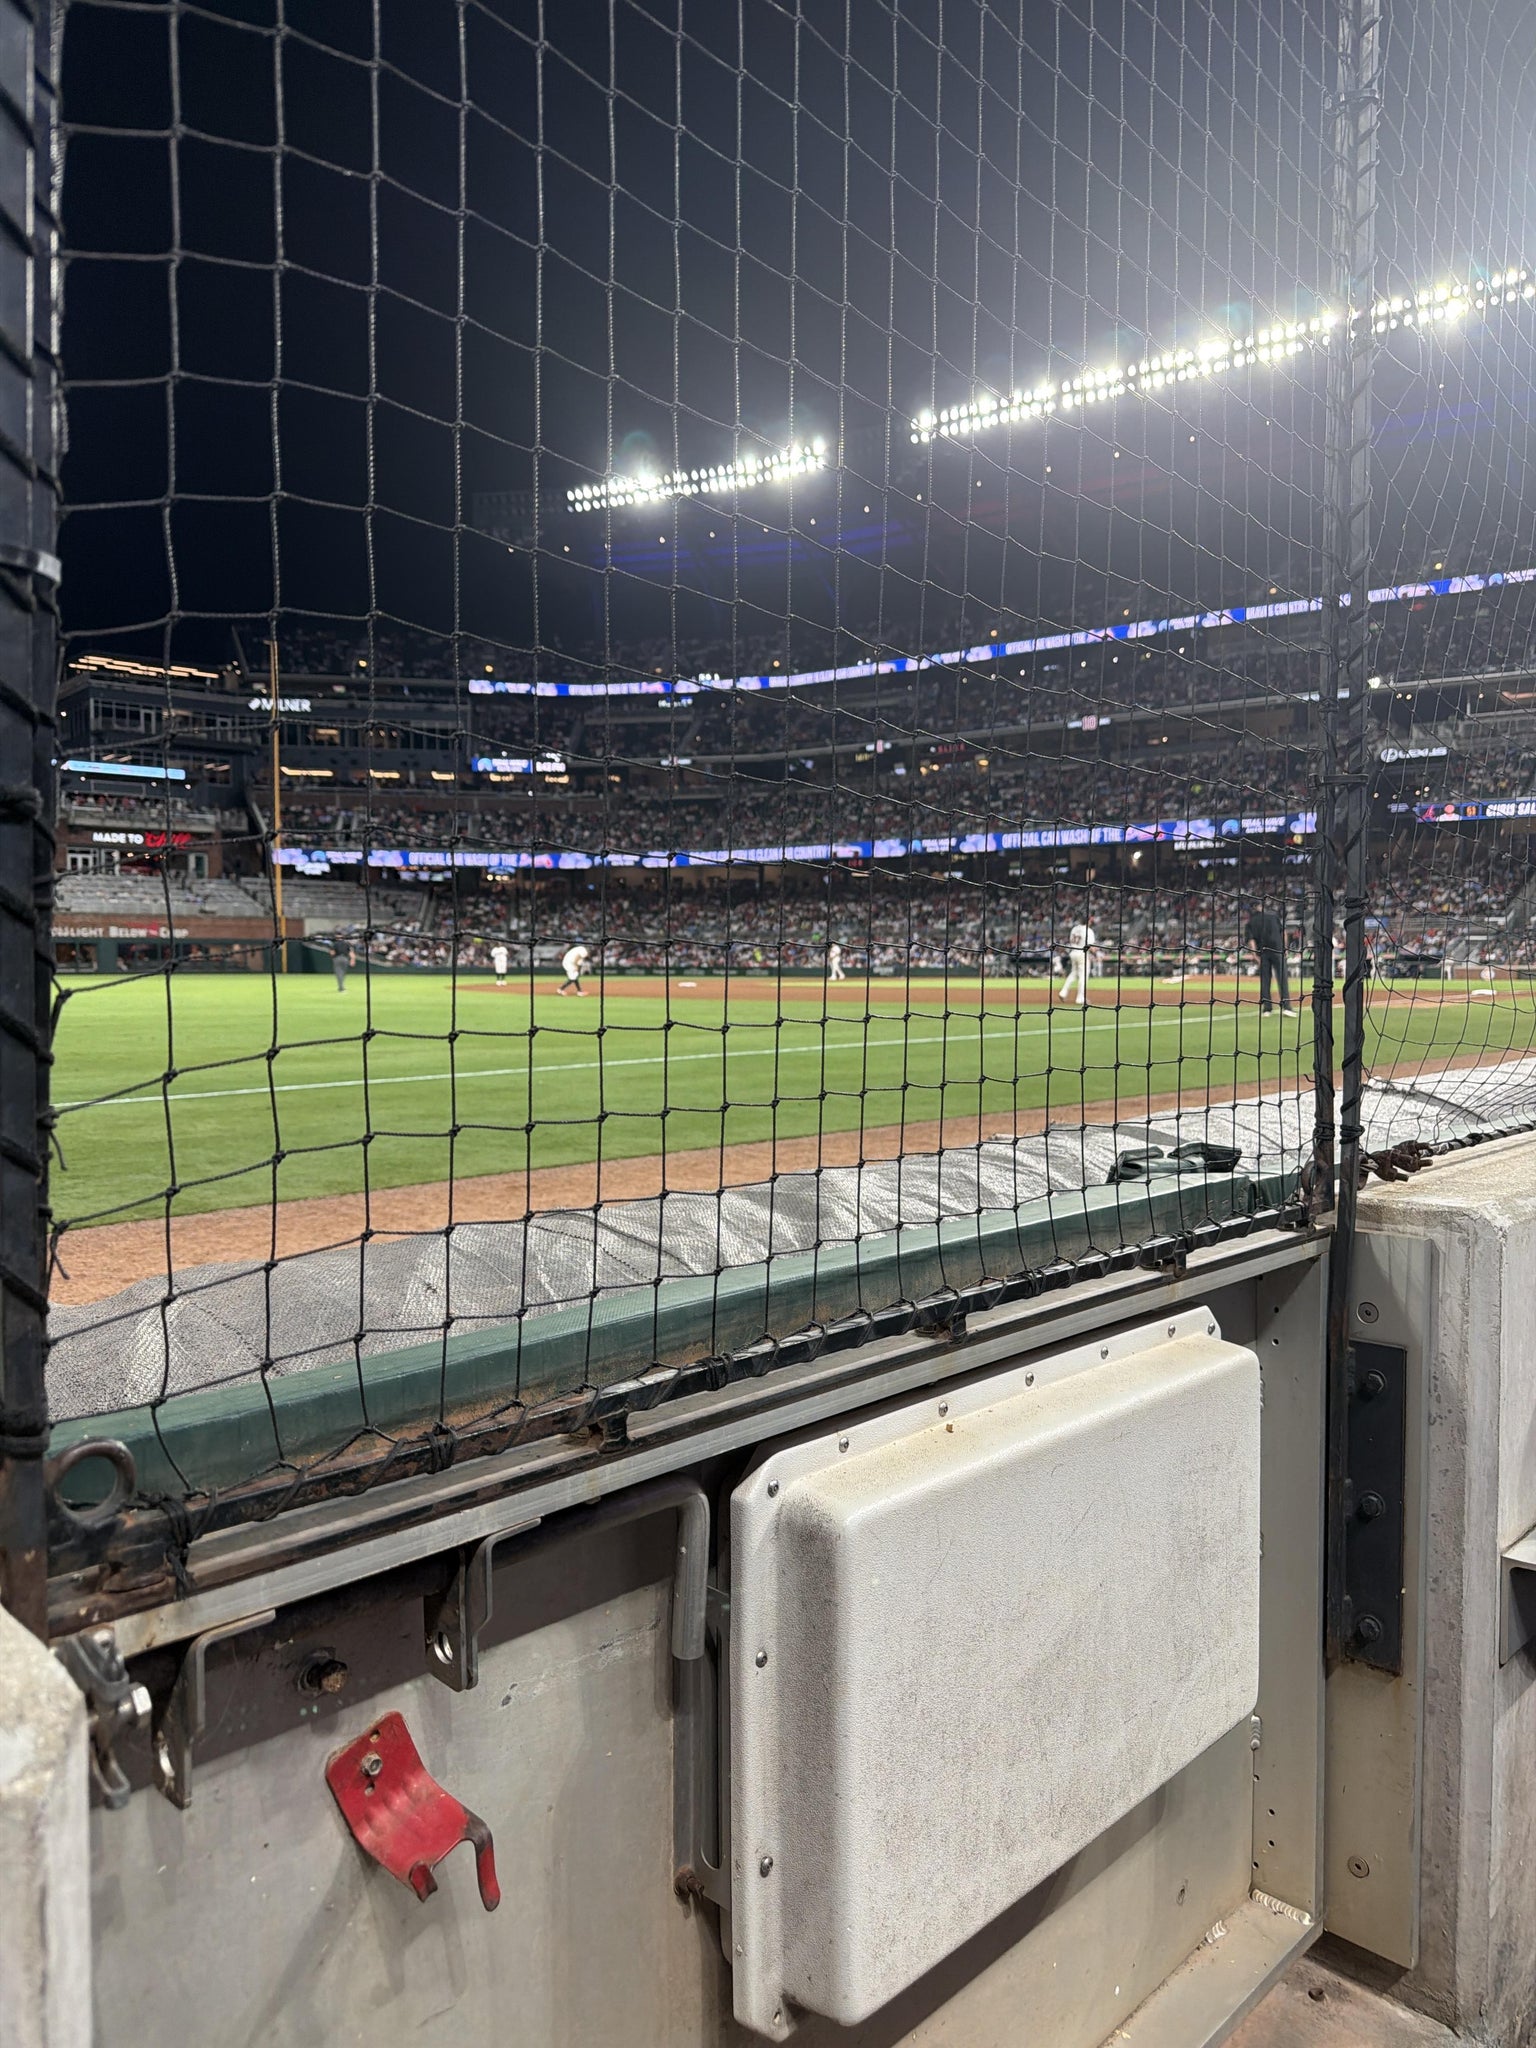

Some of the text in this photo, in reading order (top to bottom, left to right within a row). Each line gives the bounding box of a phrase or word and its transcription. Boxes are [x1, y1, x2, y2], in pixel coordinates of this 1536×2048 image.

[261, 698, 312, 712] MLNER
[1399, 747, 1448, 759] LEXUS
[1486, 803, 1516, 817] CHRIS
[93, 832, 126, 843] MADE
[128, 833, 144, 844] TO
[1002, 832, 1040, 849] OFFICIAL
[1041, 830, 1061, 846] CAR
[1061, 828, 1089, 845] WASH
[1103, 827, 1121, 842] THE
